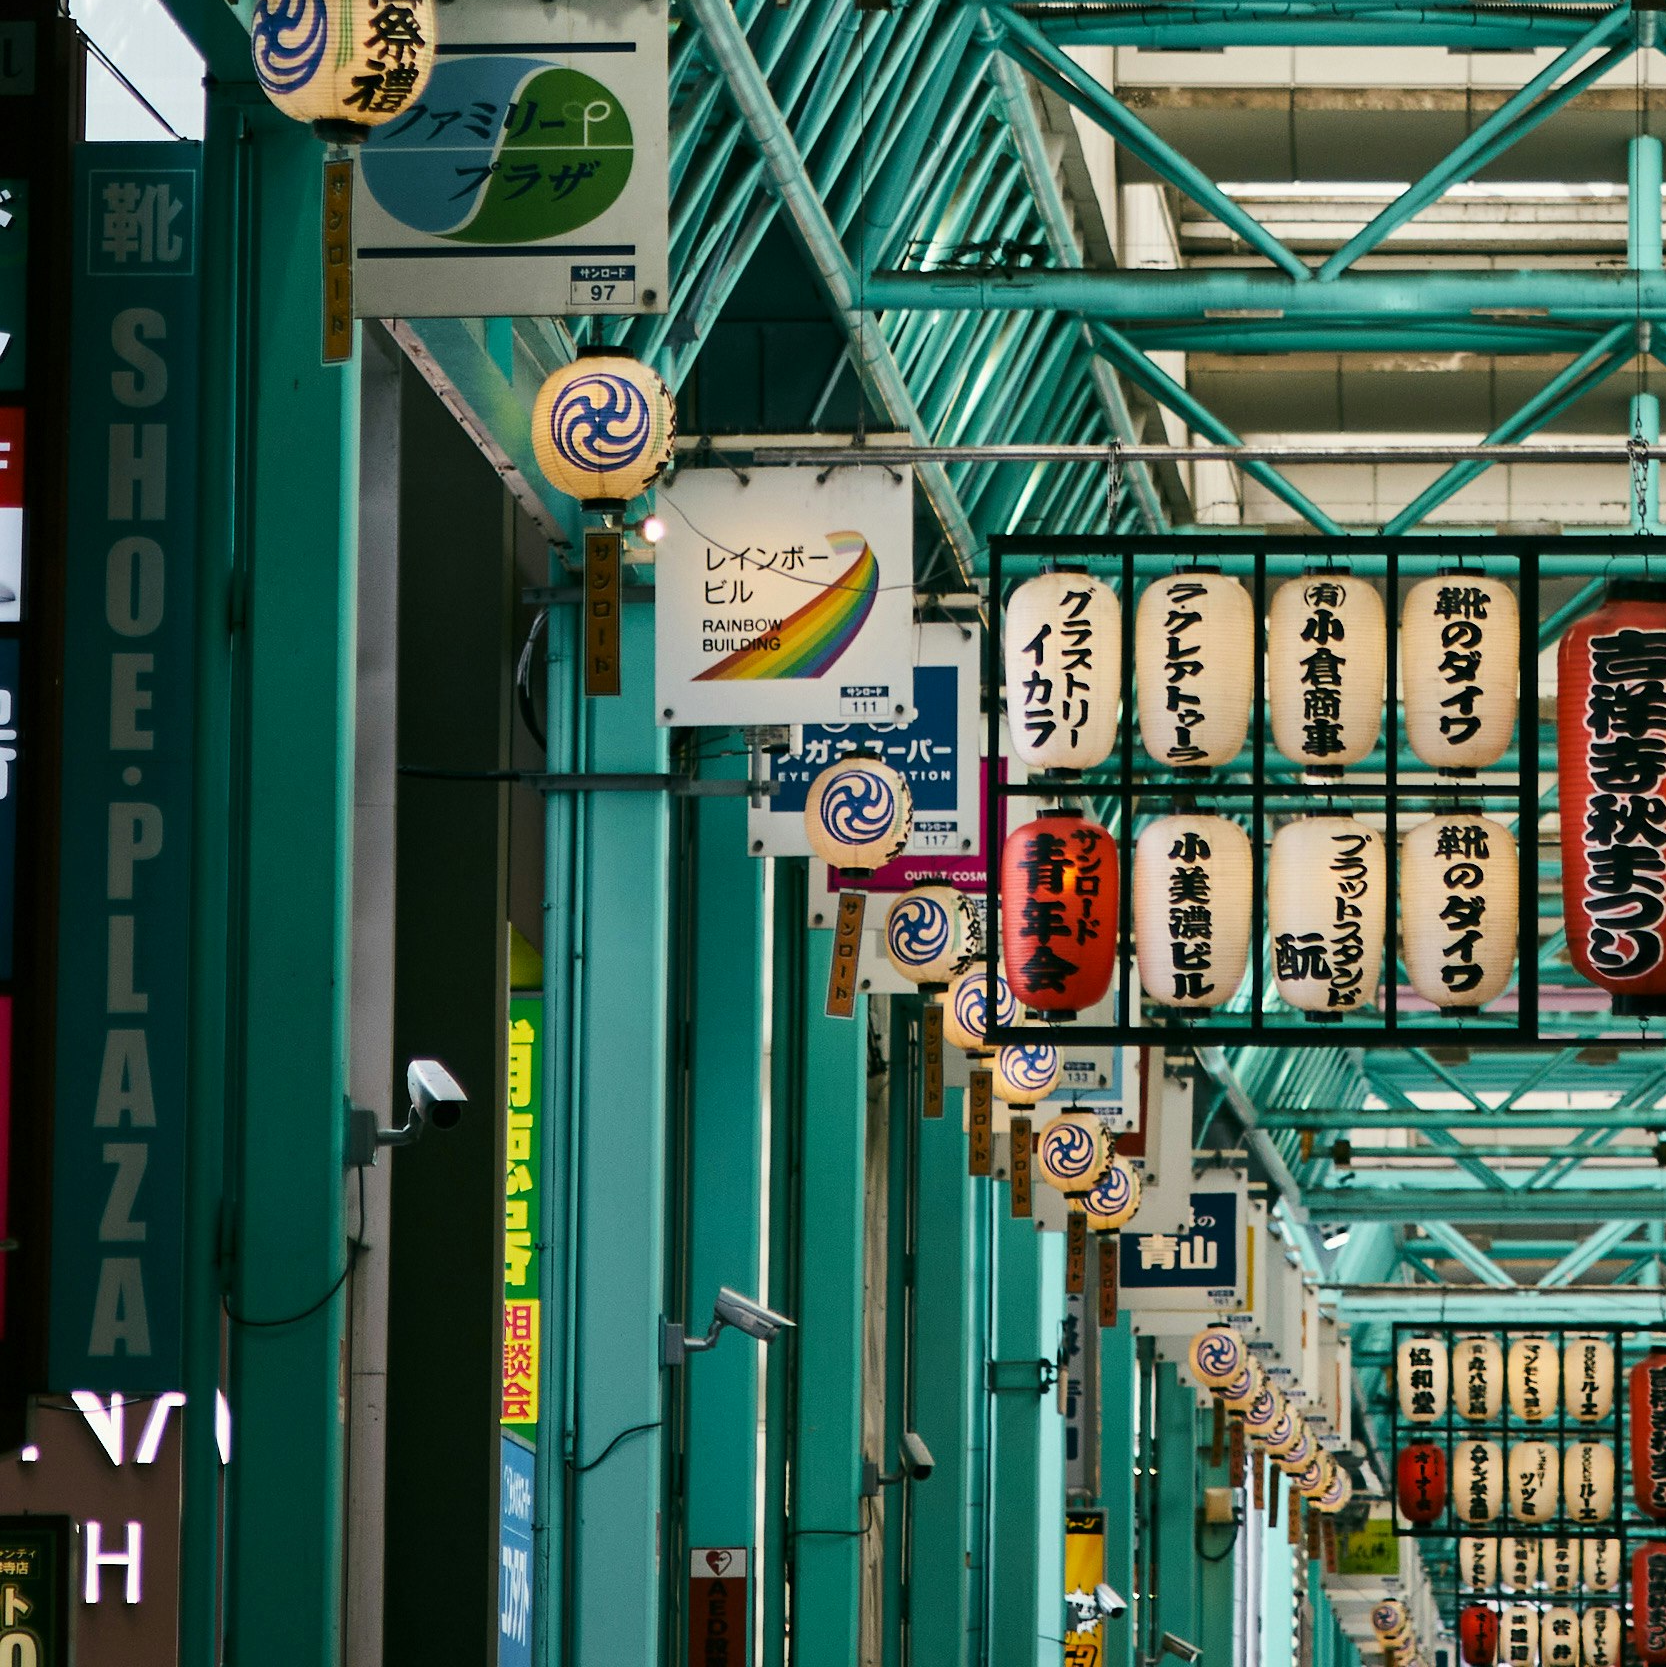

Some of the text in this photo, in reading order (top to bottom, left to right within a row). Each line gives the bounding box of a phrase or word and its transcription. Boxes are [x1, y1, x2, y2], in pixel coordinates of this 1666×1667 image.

[448, 160, 601, 202] プラザ
[101, 181, 183, 265] 靴
[579, 267, 628, 279] サンロード
[590, 285, 617, 302] 97
[705, 546, 829, 572] レインボー
[704, 579, 754, 605] ビル
[702, 618, 783, 633] RAINBOW
[702, 637, 781, 653] BUILDING
[1021, 623, 1058, 749] イカラ
[1060, 586, 1097, 749] グラストリー
[1300, 582, 1348, 758] (有)小倉商事
[1434, 586, 1492, 746] 靴のダイワ
[846, 686, 883, 697] サンロード
[851, 700, 878, 714] 111
[777, 771, 810, 783] EYE
[924, 834, 949, 847] 117
[1070, 828, 1101, 947] サンロード
[1434, 825, 1491, 993] 靴のダイワ
[1019, 832, 1079, 994] 青年会
[1167, 831, 1216, 1001] 小美濃ビル
[1329, 833, 1374, 1008] プラットスタンド
[1137, 1233, 1218, 1270] 青山
[1409, 1347, 1436, 1415] 協和堂
[1520, 1472, 1537, 1516] ツツミ
